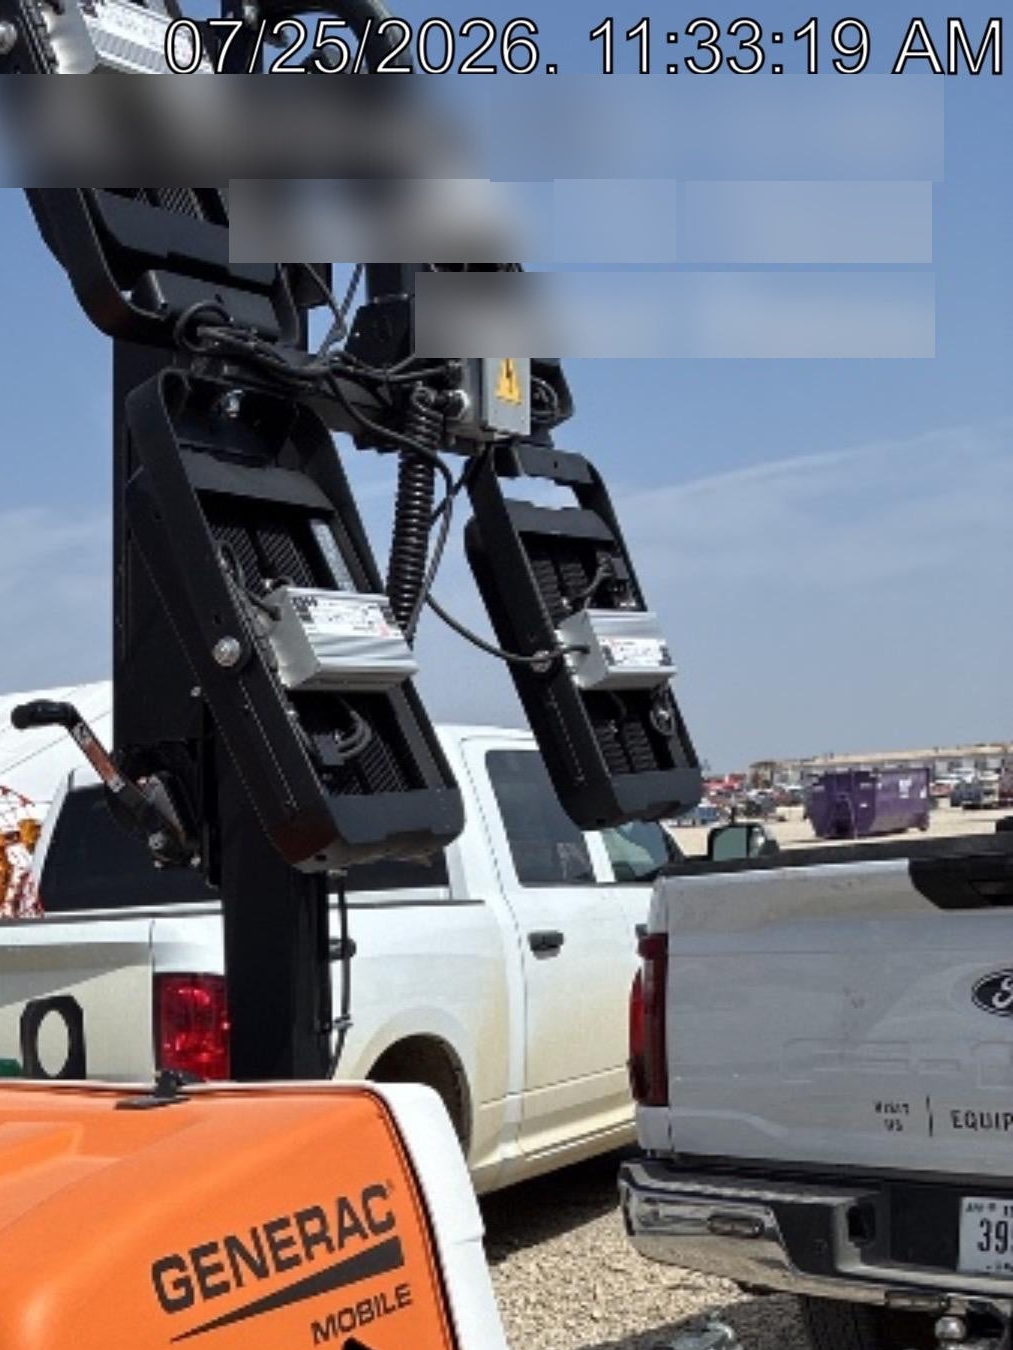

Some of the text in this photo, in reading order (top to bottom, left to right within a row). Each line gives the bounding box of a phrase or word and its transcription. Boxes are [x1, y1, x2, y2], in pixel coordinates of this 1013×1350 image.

[151, 1183, 398, 1315] GENERAC
[976, 1217, 1013, 1255] 39
[310, 1282, 414, 1346] MOBILE
